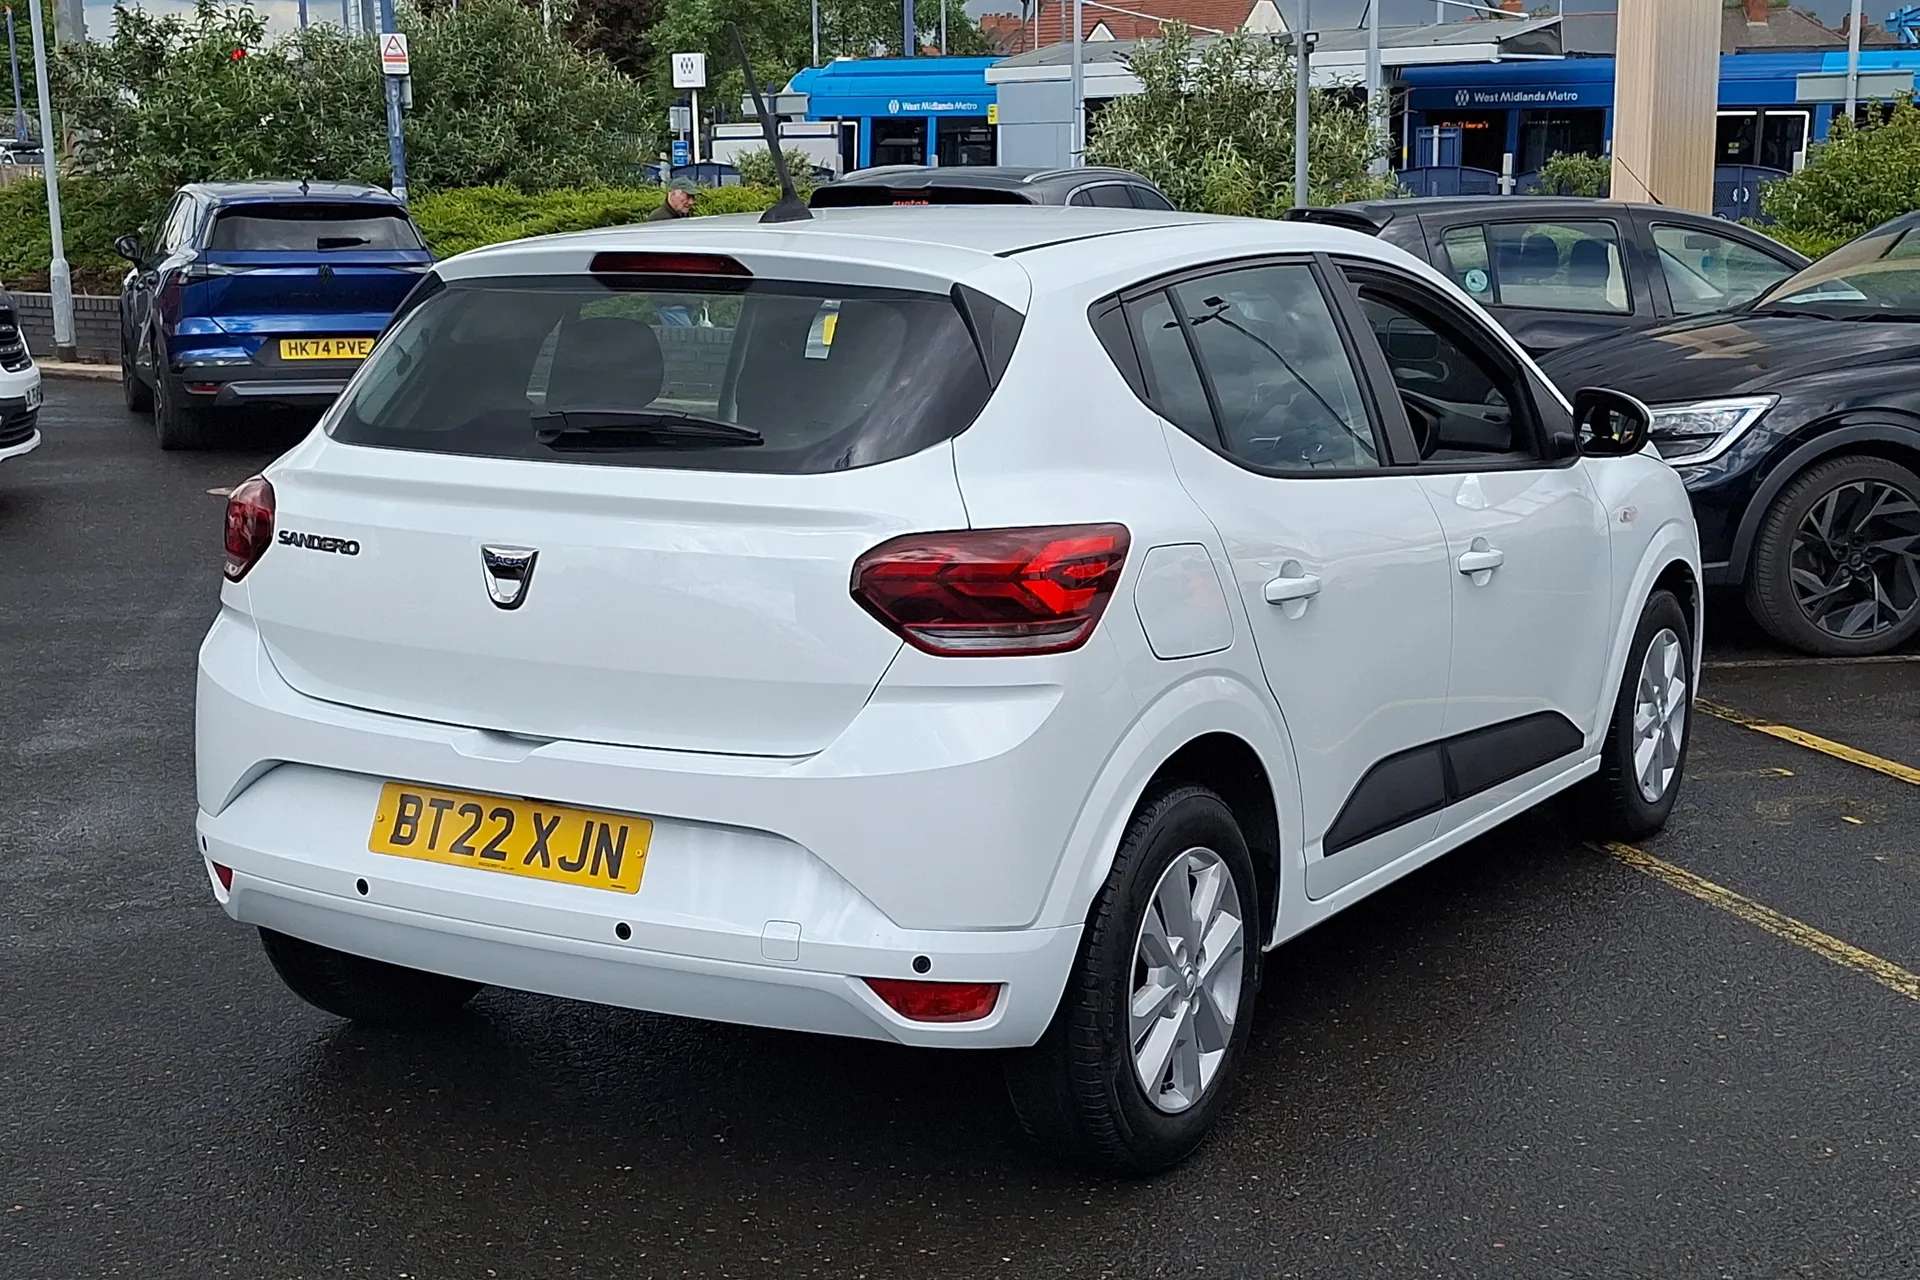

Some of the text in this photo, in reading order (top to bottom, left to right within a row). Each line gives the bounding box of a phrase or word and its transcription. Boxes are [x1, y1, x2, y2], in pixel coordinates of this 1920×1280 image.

[1474, 90, 1578, 103] West Midlands Metro
[955, 101, 978, 110] Metro
[288, 340, 369, 356] HK74 PVE
[278, 530, 360, 556] SANDERO
[389, 793, 629, 880] BT22 XJN
